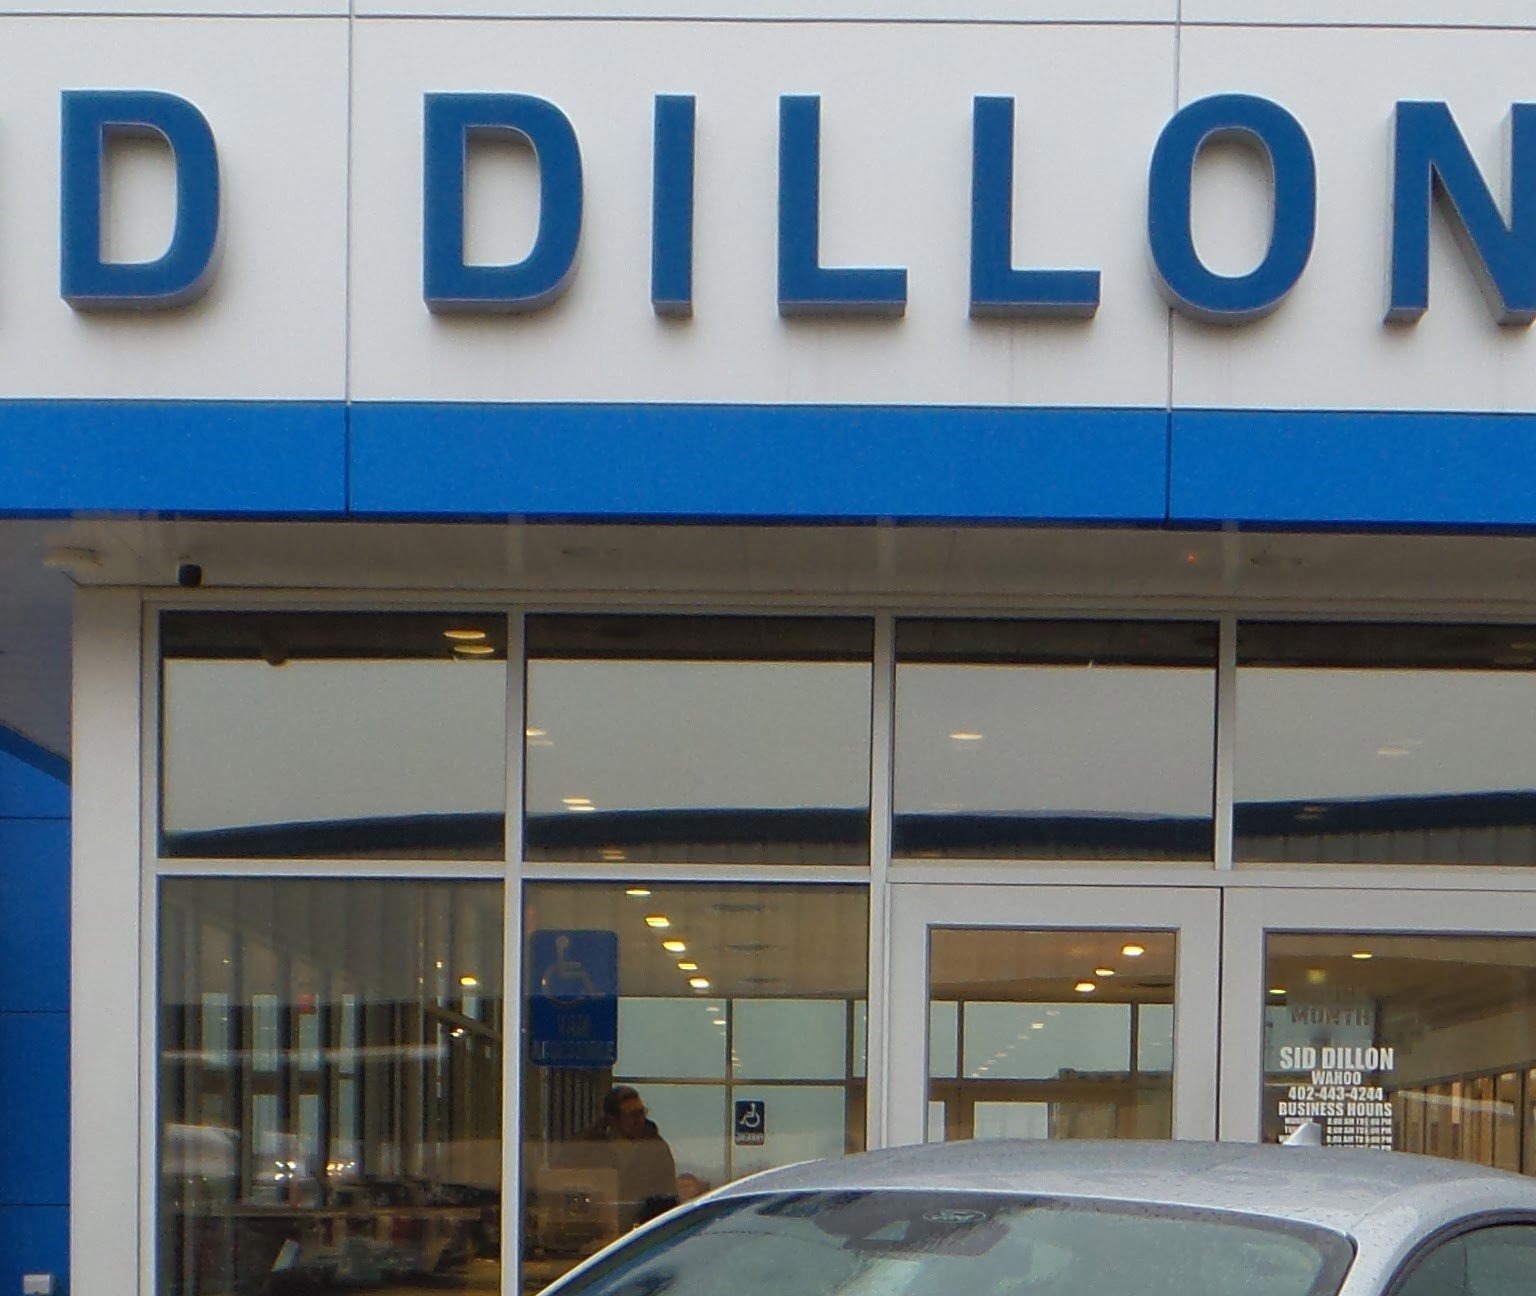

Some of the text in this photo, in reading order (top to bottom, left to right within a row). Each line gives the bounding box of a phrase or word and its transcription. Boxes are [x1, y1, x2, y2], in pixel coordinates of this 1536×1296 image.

[1280, 1047, 1394, 1070] SID DILLON
[1311, 1071, 1362, 1085] WAHOO
[1288, 1086, 1383, 1100] 402-443-4244
[1279, 1102, 1393, 1117] BUSINESS HOURS
